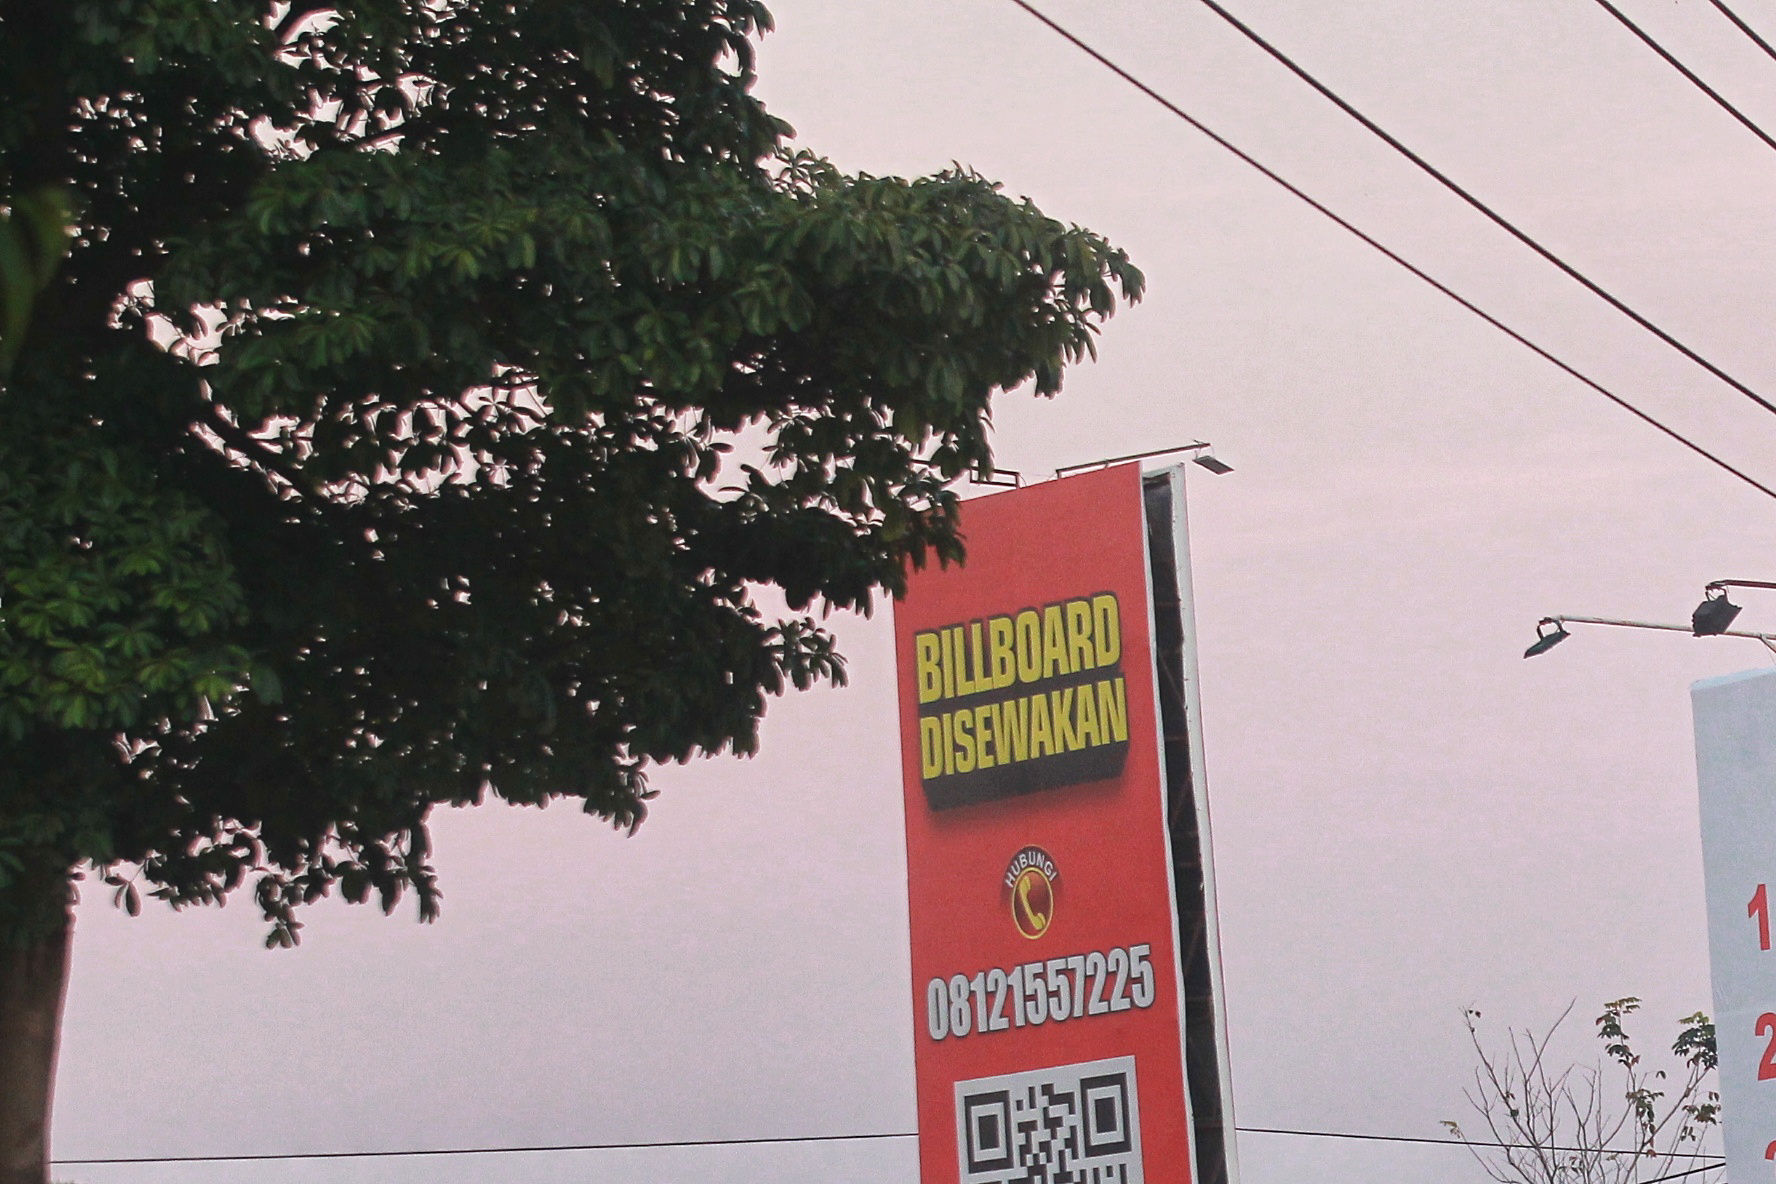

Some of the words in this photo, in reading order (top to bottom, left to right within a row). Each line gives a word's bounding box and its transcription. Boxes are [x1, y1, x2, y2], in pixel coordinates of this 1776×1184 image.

[916, 593, 1121, 705] BILLBOARD
[920, 678, 1129, 781] DISEWAKAN
[1005, 851, 1058, 888] HUBUNGI
[927, 945, 1156, 1042] 08121557225
